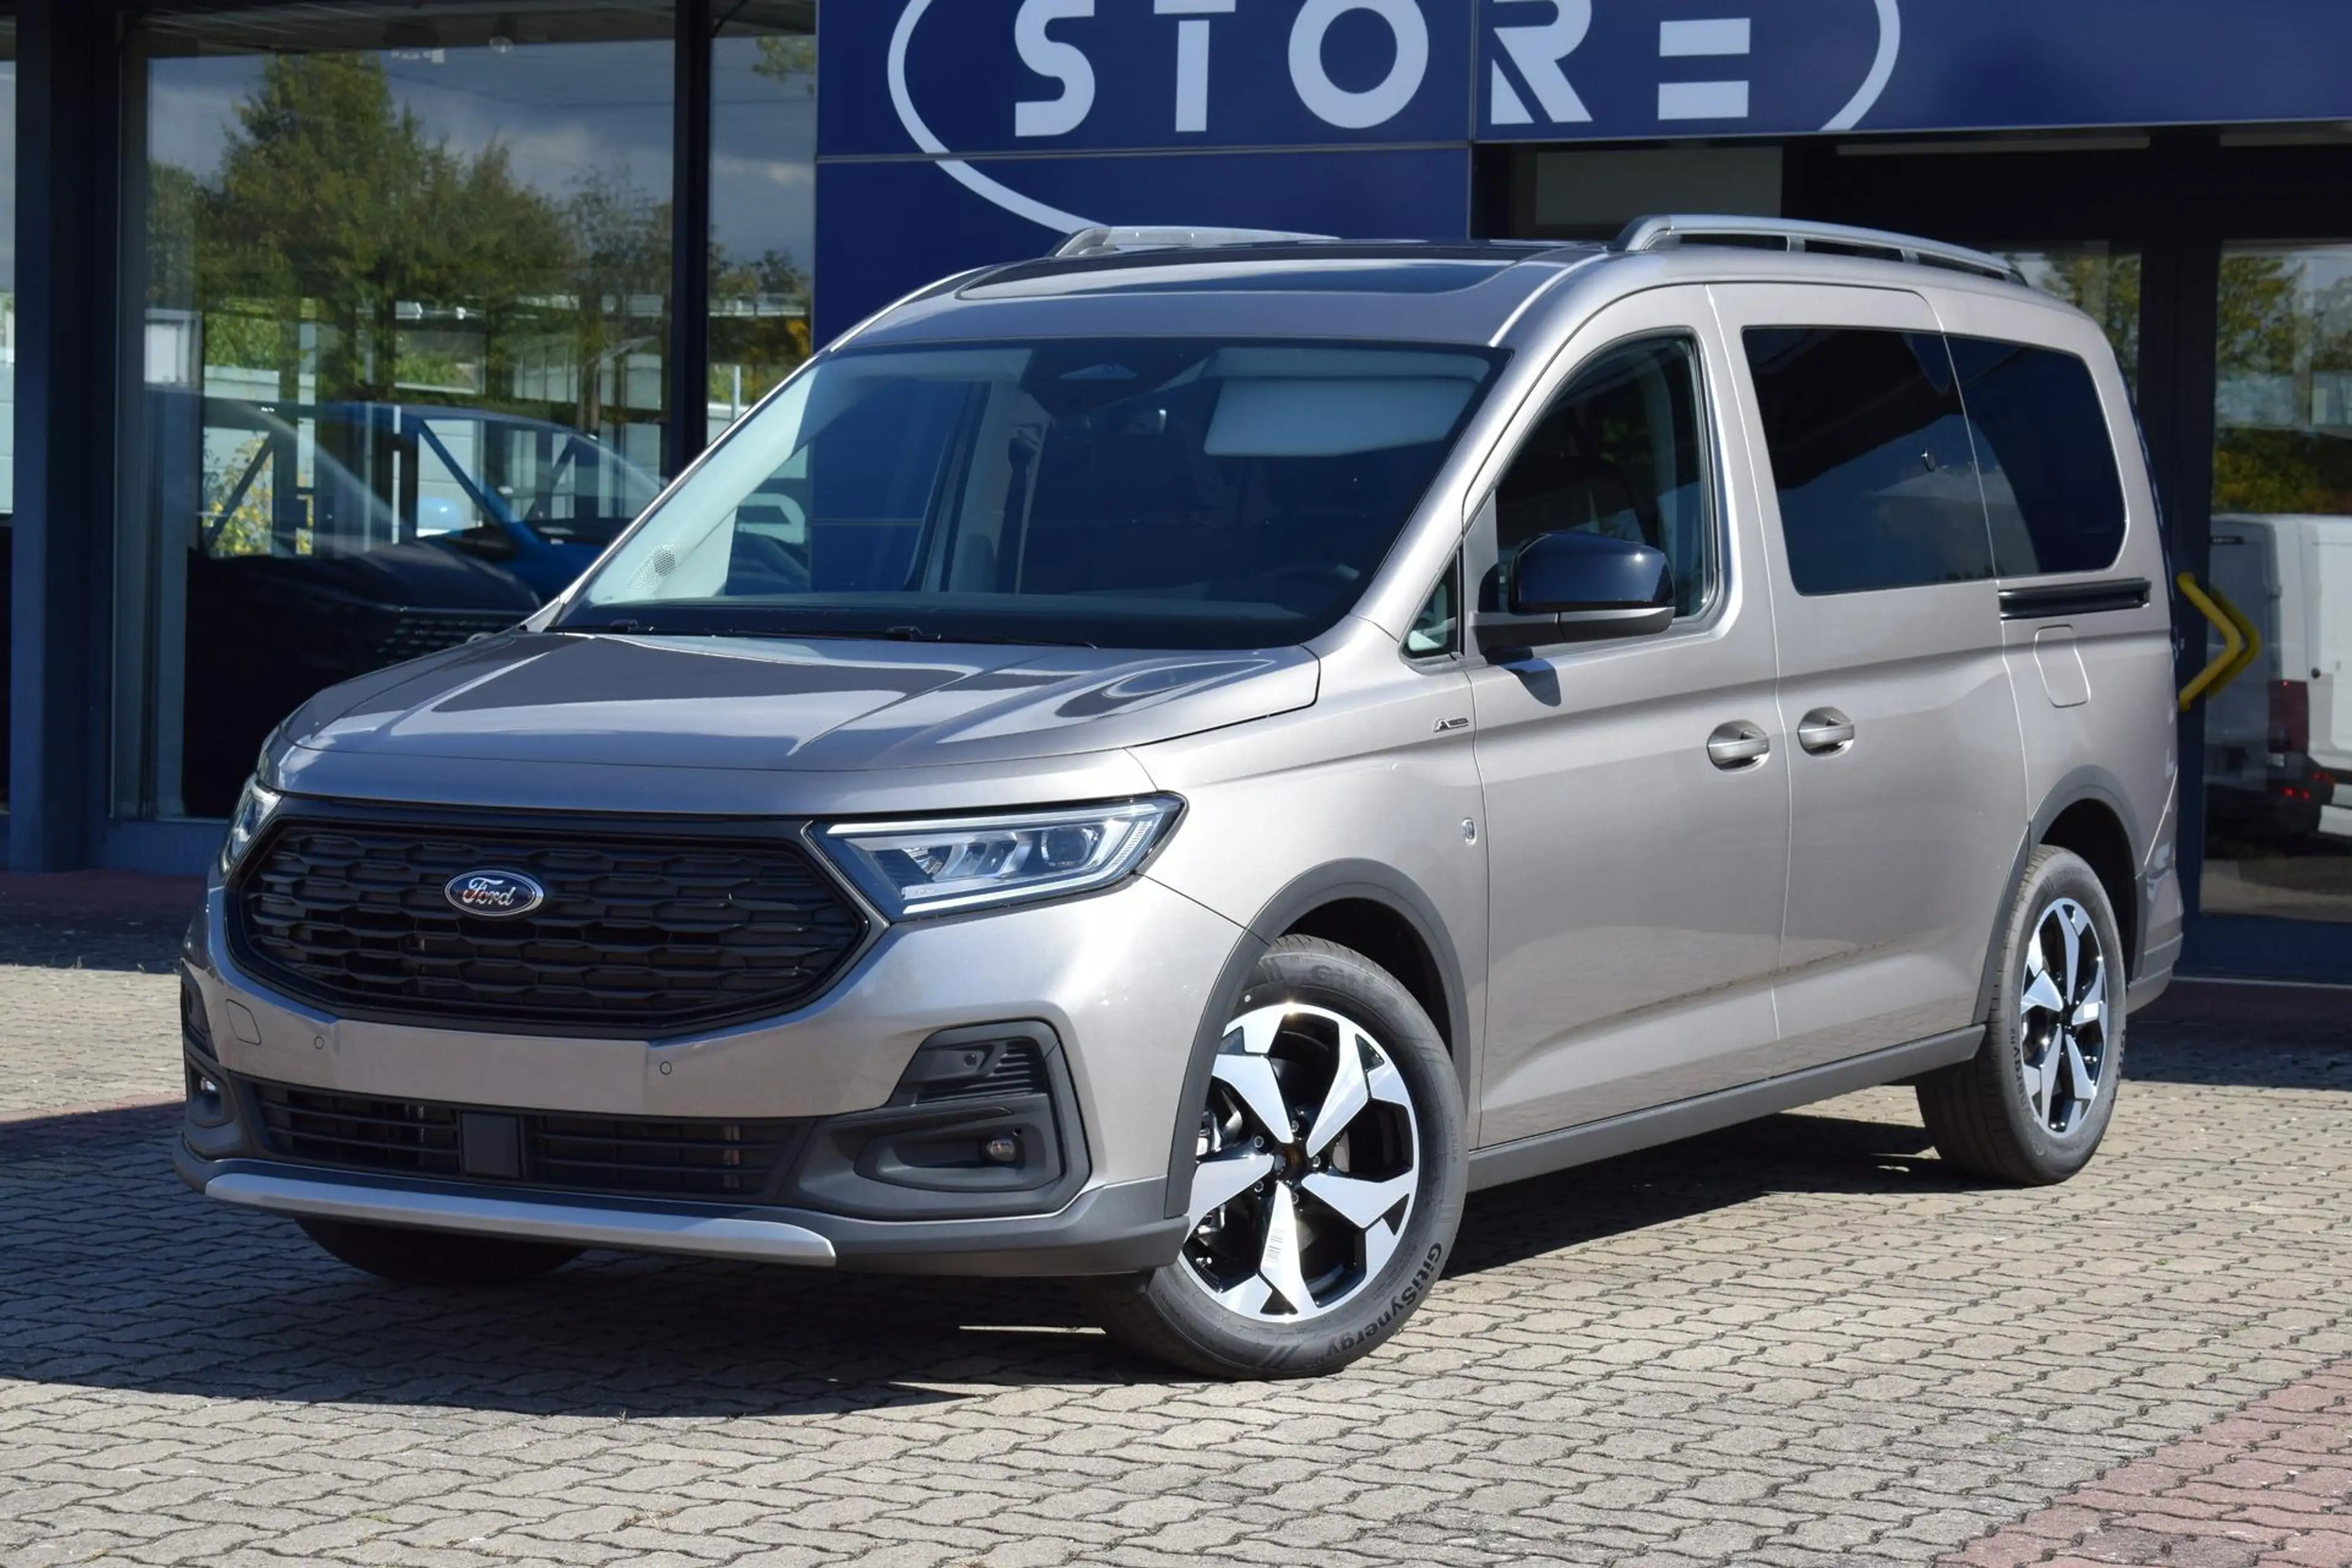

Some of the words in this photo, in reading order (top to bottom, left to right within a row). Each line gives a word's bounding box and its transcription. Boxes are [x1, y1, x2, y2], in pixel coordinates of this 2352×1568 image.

[1014, 0, 1751, 137] STORE
[462, 877, 516, 907] Ford
[1325, 1243, 1442, 1357] GitiSynergy
